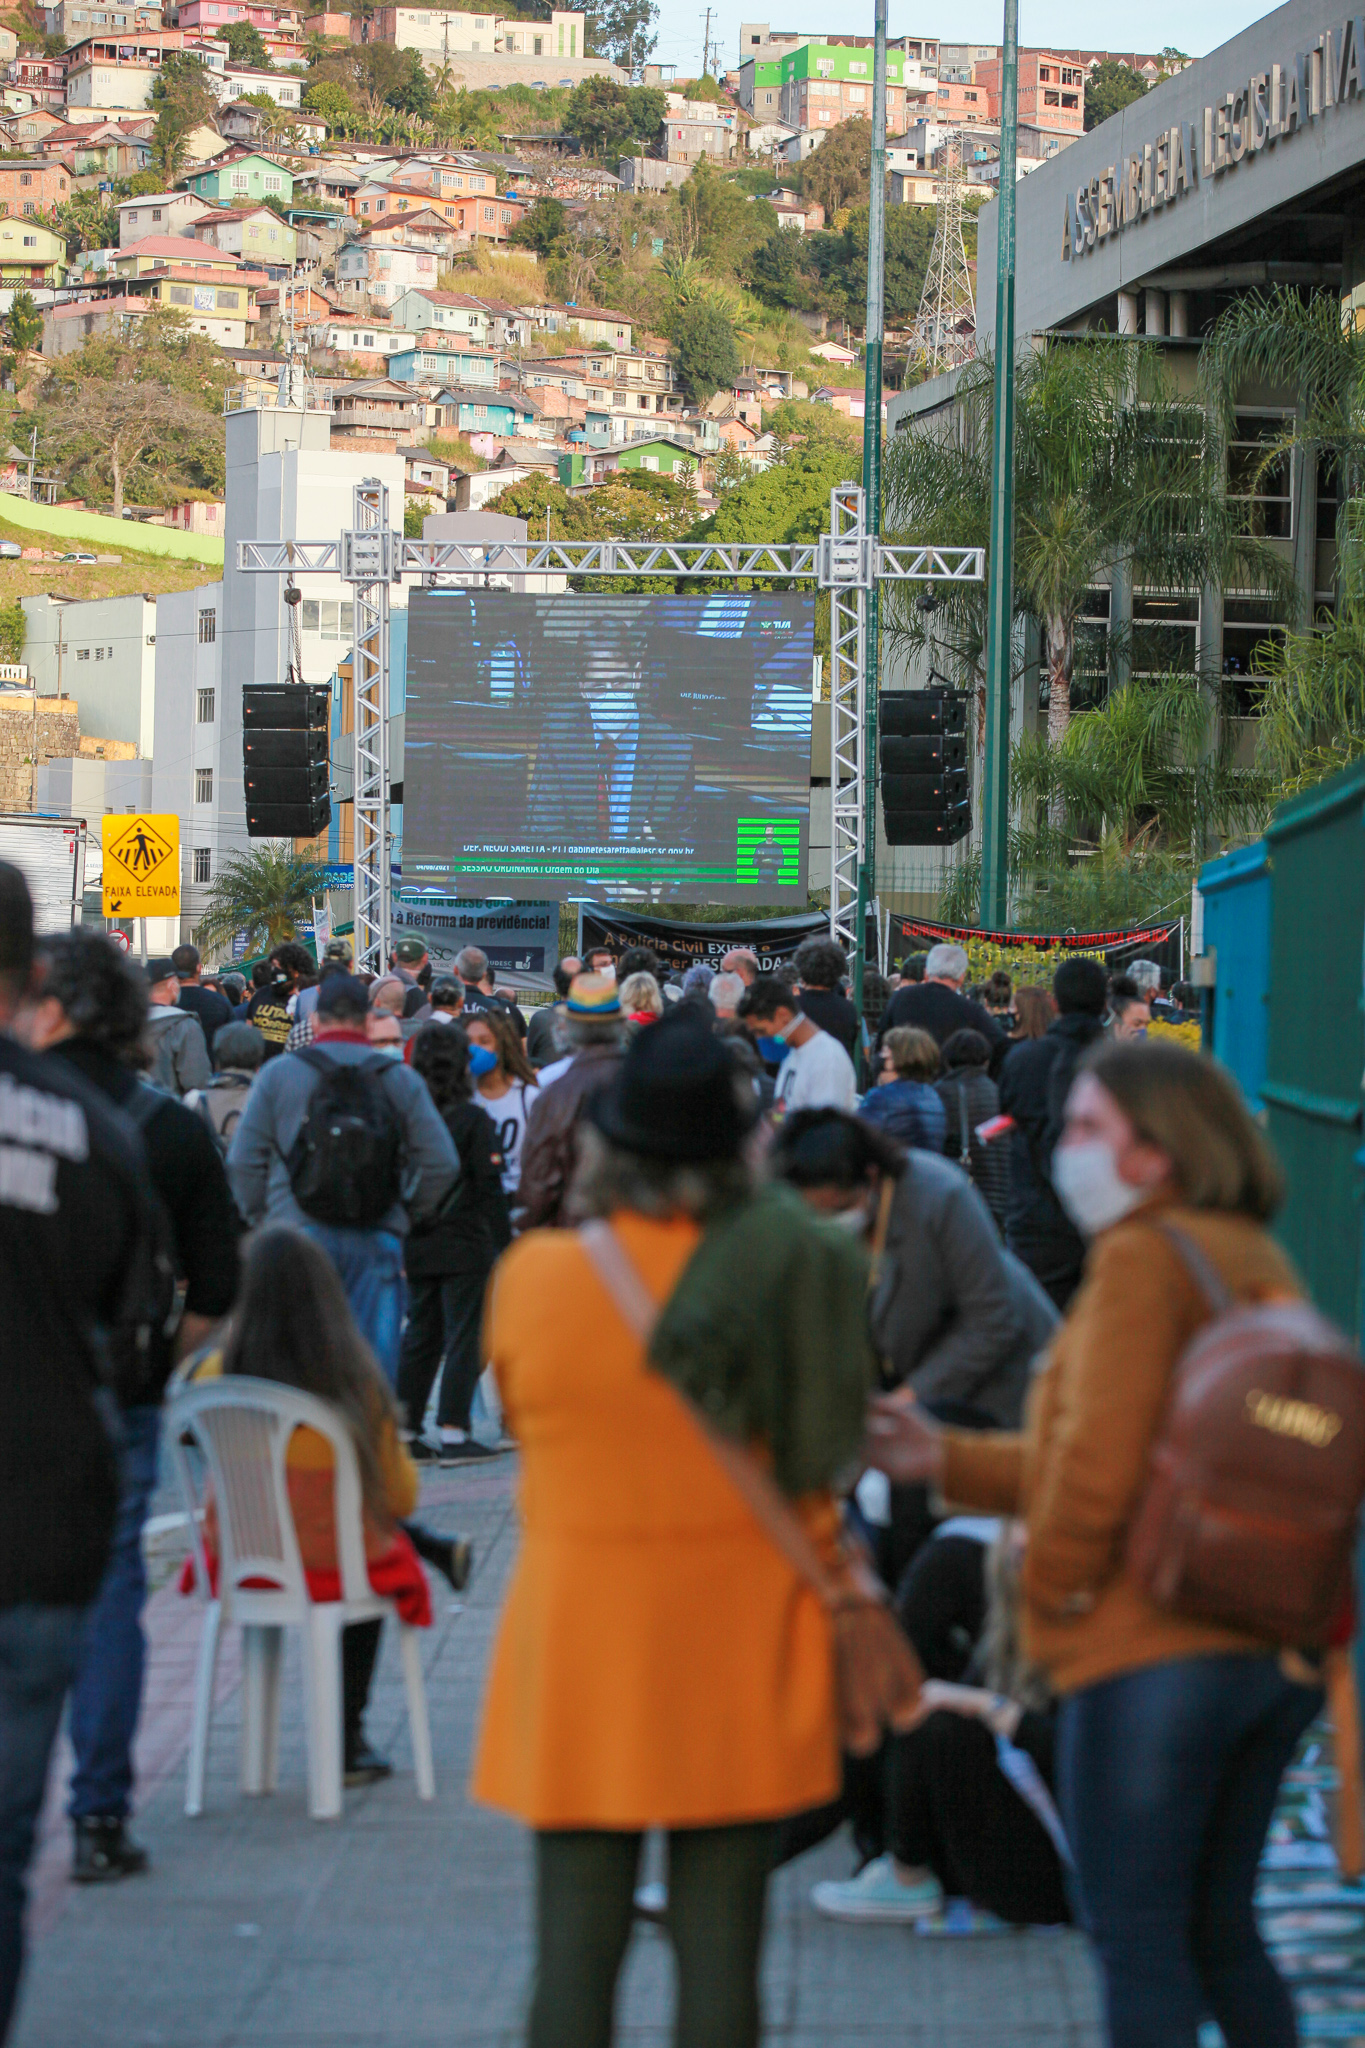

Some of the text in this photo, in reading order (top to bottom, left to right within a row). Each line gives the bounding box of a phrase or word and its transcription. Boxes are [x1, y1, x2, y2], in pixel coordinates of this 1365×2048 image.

[1061, 15, 1365, 262] ASSEMBLEIA LEGISLATIVA
[105, 885, 178, 897] FAIXA ELEVADA
[406, 911, 457, 929] Reforma
[459, 914, 475, 929] da
[476, 914, 550, 930] previdência!
[604, 932, 615, 946] A
[672, 940, 704, 954] Civil
[1065, 930, 1125, 947] SEGURANÇA
